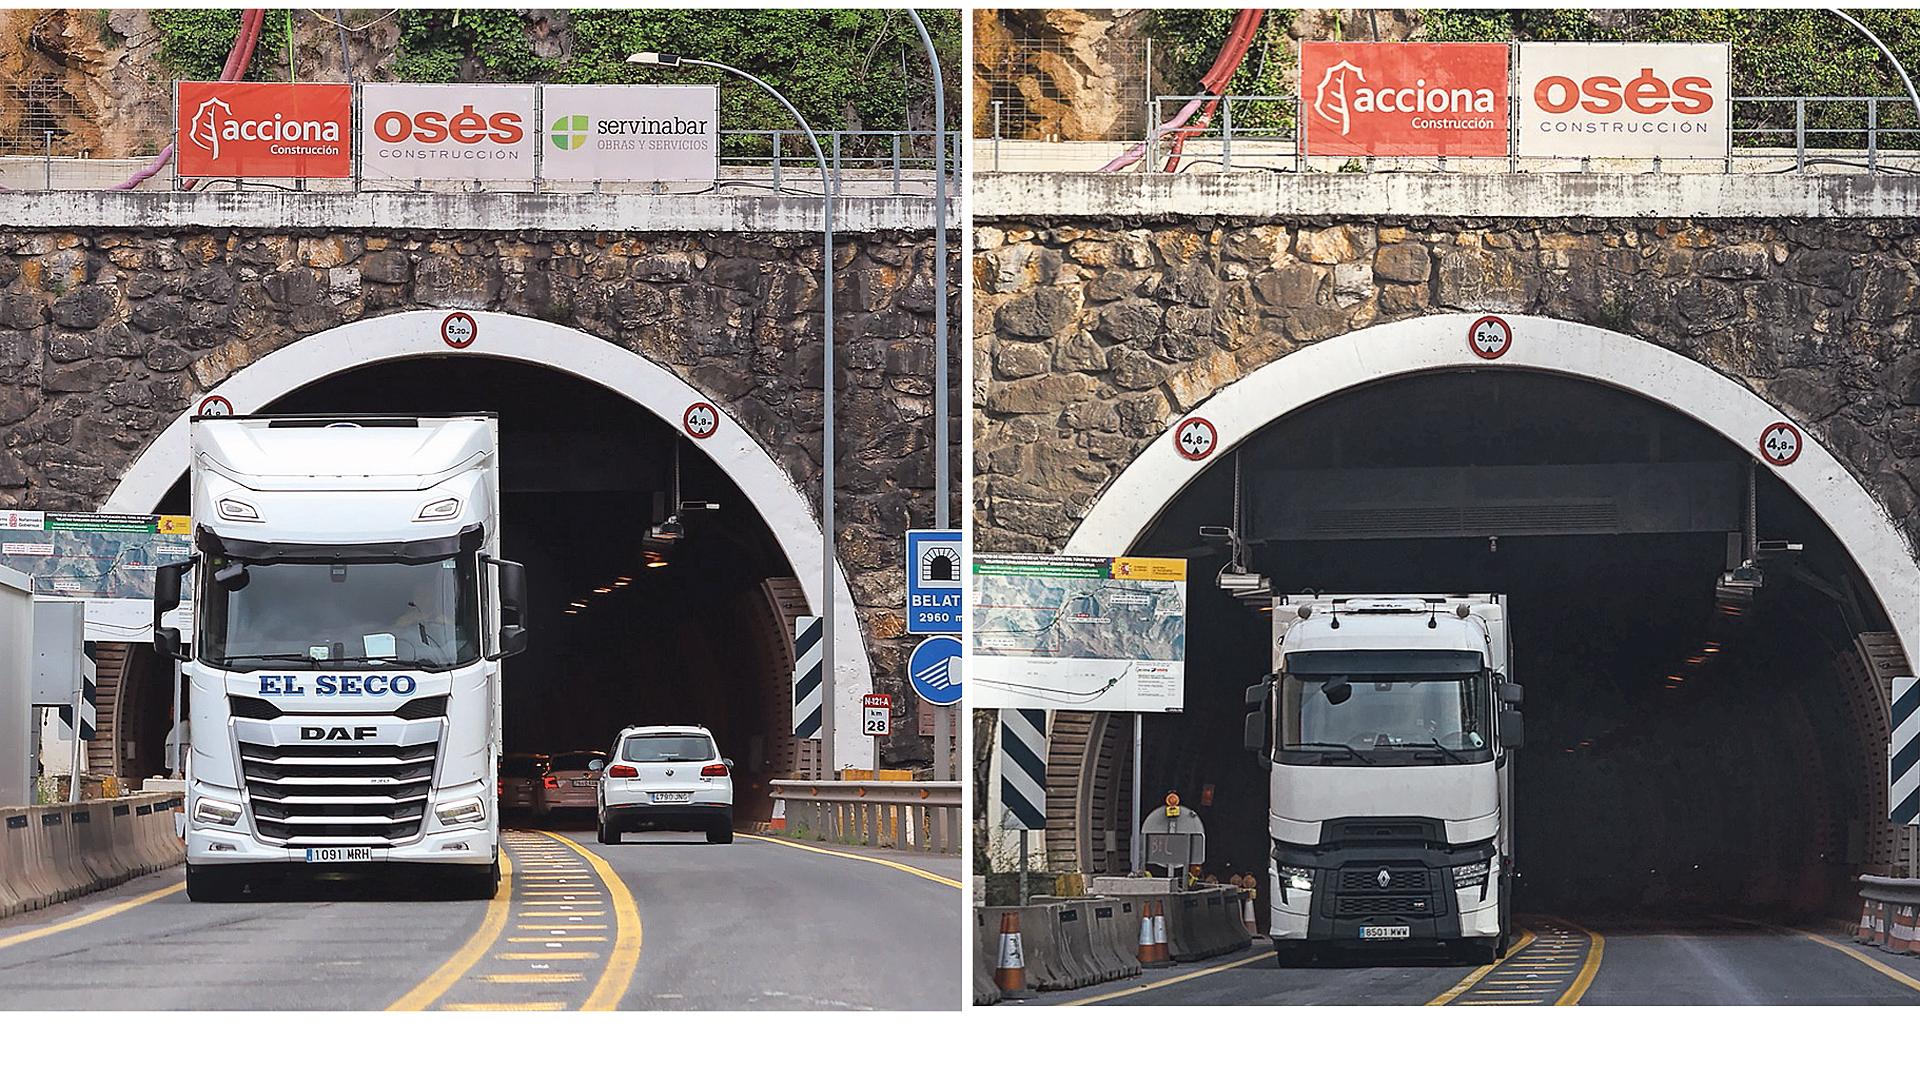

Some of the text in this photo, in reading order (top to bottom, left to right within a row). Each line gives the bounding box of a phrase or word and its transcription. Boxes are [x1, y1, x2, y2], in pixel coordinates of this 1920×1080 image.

[1353, 78, 1494, 113] acciona
[1533, 68, 1714, 114] osés
[221, 112, 339, 141] acciona
[374, 105, 524, 144] osés
[597, 116, 708, 135] servinabar
[1411, 116, 1494, 129] Construcción
[1540, 120, 1707, 133] CONSTRUCCIÓN
[270, 144, 338, 155] Construcción
[597, 139, 708, 150] OBRAS Y SERVICIOS
[379, 149, 519, 160] CONSTRUCCIÓN
[912, 594, 961, 607] BELAT
[919, 612, 950, 623] 2960
[258, 674, 418, 697] EL SECO
[867, 720, 886, 732] 28
[300, 726, 378, 740] DAF
[315, 848, 370, 860] 1091 MRH
[1366, 928, 1388, 937] 8501
